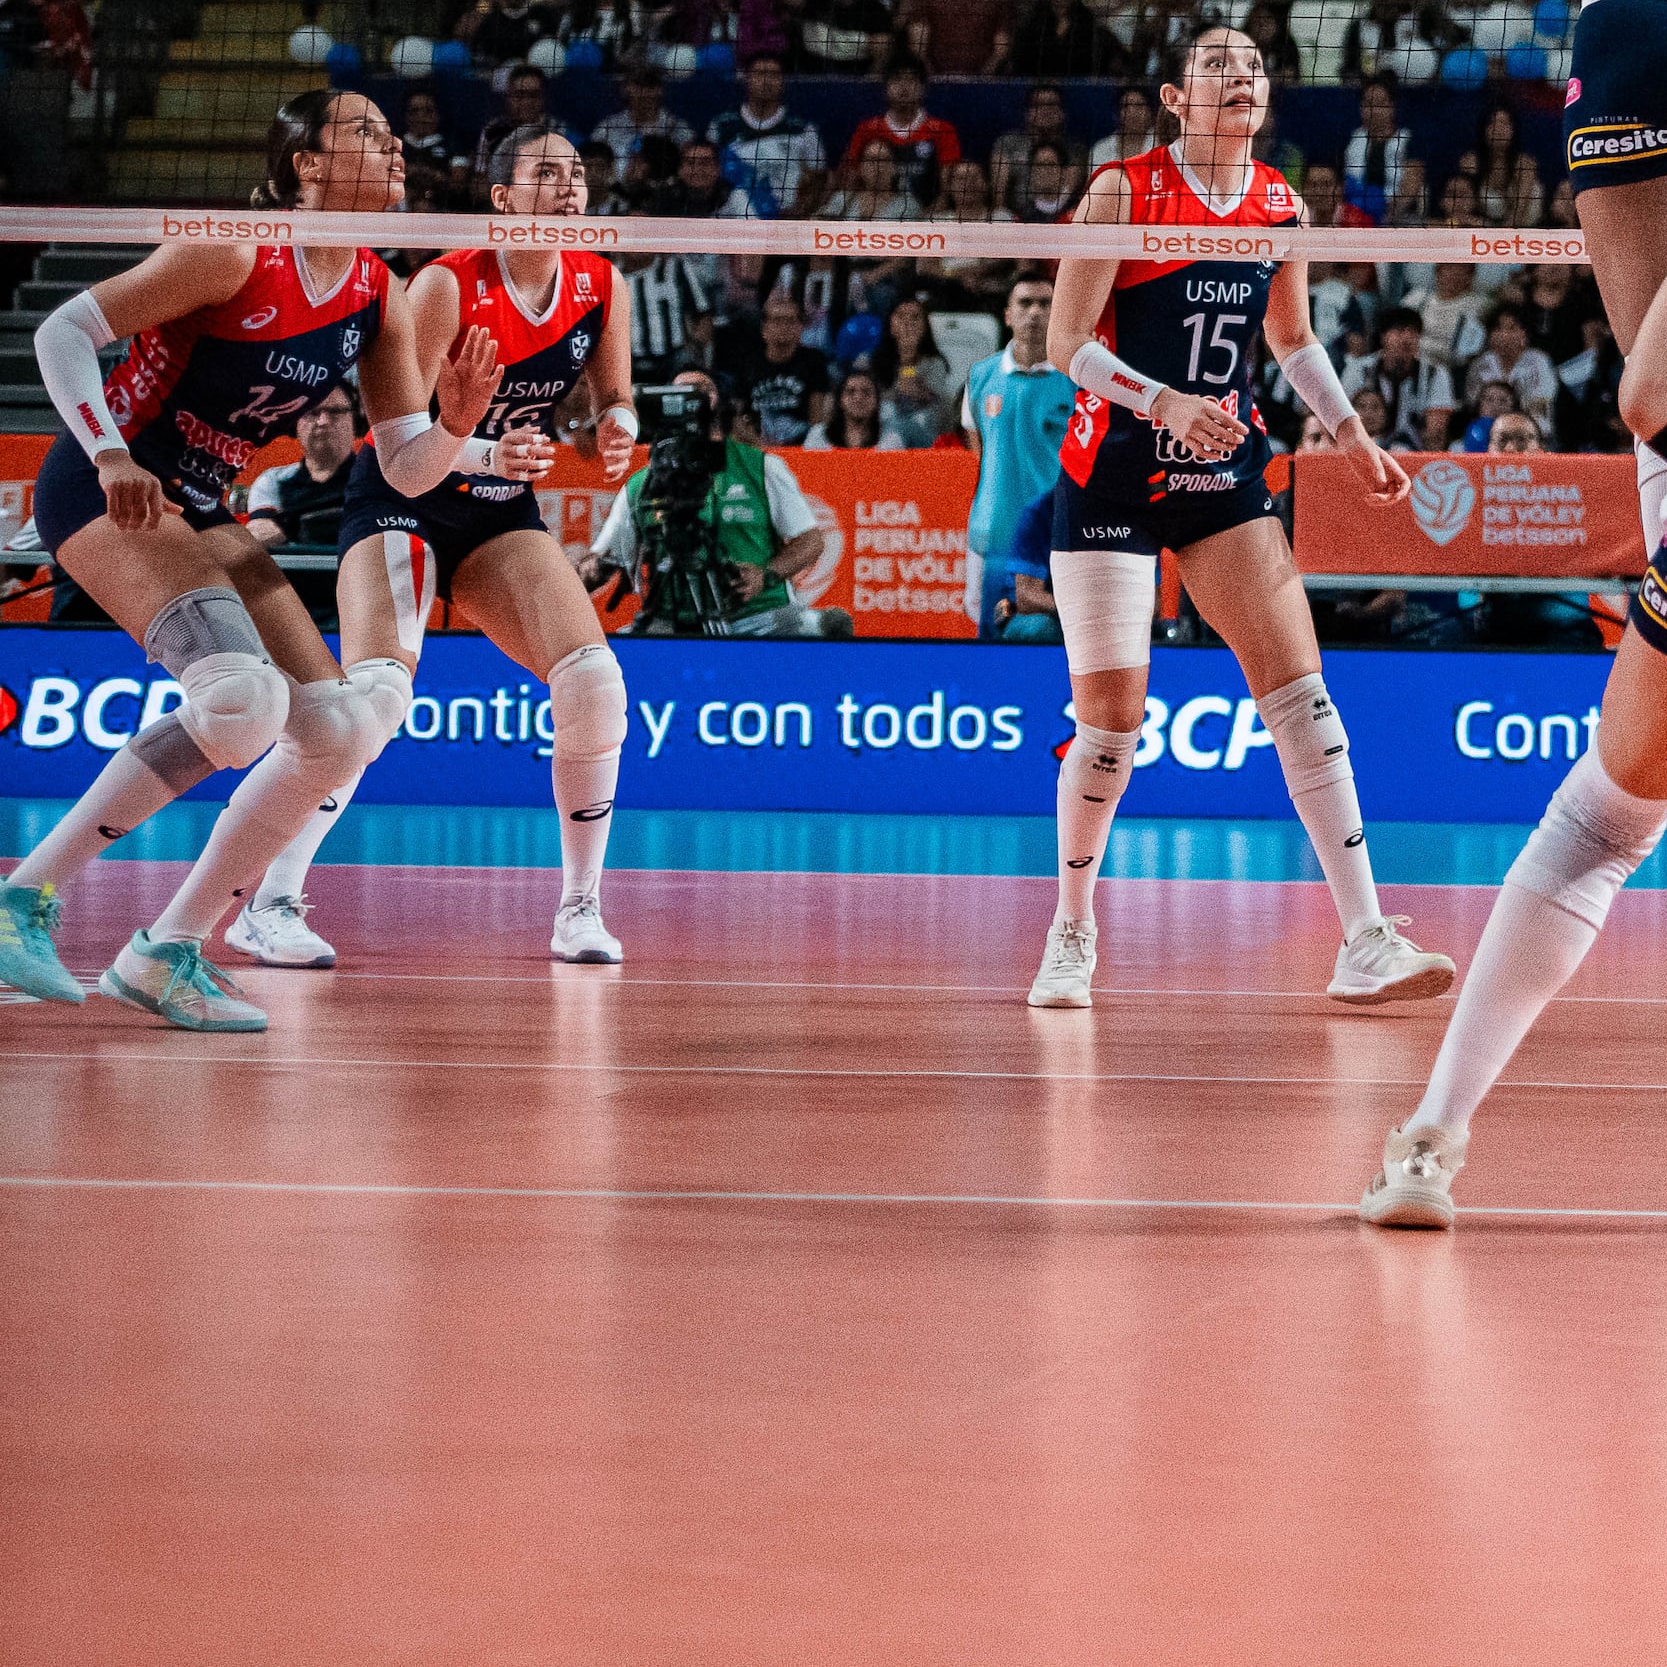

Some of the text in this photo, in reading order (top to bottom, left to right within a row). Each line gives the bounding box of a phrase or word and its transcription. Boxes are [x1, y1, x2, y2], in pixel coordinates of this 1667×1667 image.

[163, 215, 292, 240] betsson
[488, 221, 618, 245] betsson
[814, 228, 946, 251] betsson
[1143, 231, 1273, 255] betsson
[1470, 234, 1588, 258] betsso
[1186, 280, 1252, 305] USMP
[1182, 312, 1247, 385] 15
[265, 350, 329, 387] USMP
[495, 380, 565, 398] USMP
[1110, 372, 1147, 395] MNBK
[1168, 471, 1238, 492] SPORADE
[1483, 466, 1531, 483] LIGA
[1483, 486, 1582, 504] PERUANA
[377, 516, 418, 529] USMP
[854, 501, 920, 525] LIGA
[1483, 507, 1519, 524] DE
[855, 529, 967, 552] PERUAN
[1083, 526, 1131, 539] USMP
[1483, 528, 1587, 545] betsson
[854, 558, 892, 582] DE
[641, 700, 675, 758] y
[698, 700, 812, 749] con
[838, 690, 1024, 752] todos
